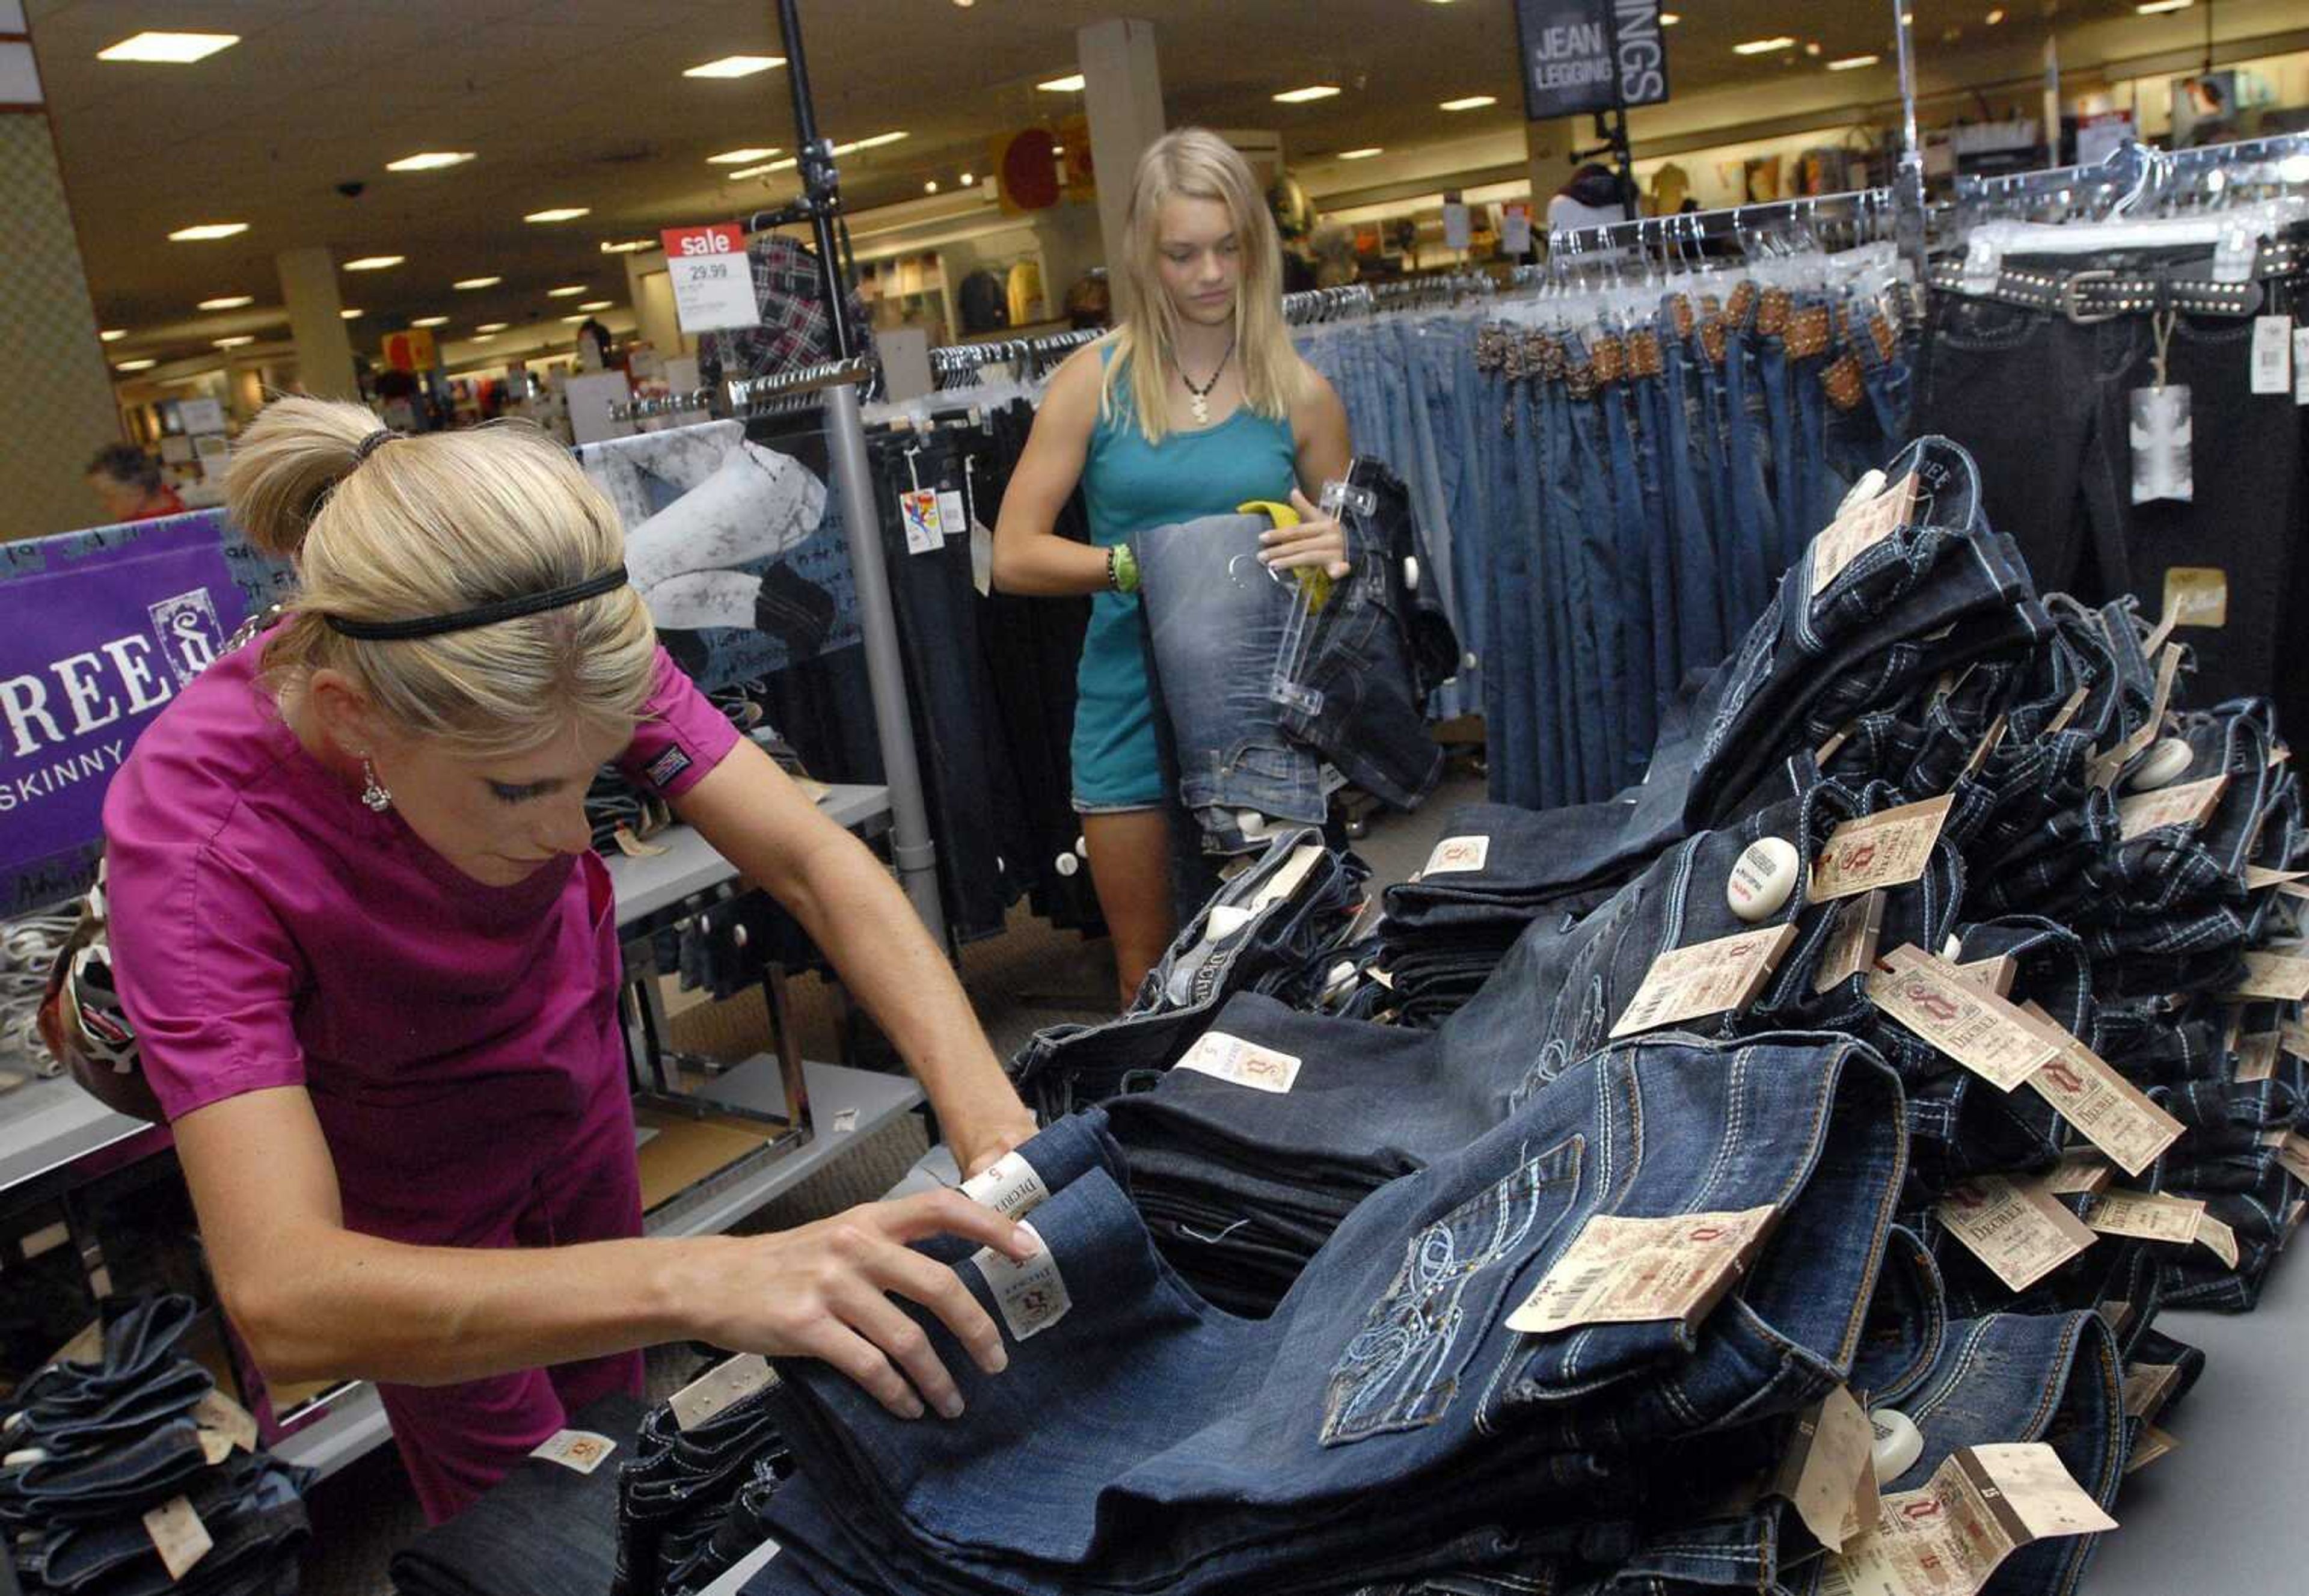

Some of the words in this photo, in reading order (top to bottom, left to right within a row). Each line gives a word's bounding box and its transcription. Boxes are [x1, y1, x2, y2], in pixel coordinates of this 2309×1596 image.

[1536, 22, 1602, 61] JEAN
[1535, 57, 1614, 90] LEGGING
[681, 228, 730, 256] sale
[691, 262, 728, 281] 29.99
[0, 738, 123, 811] SKINNY
[1970, 1202, 2025, 1242] DECREE
